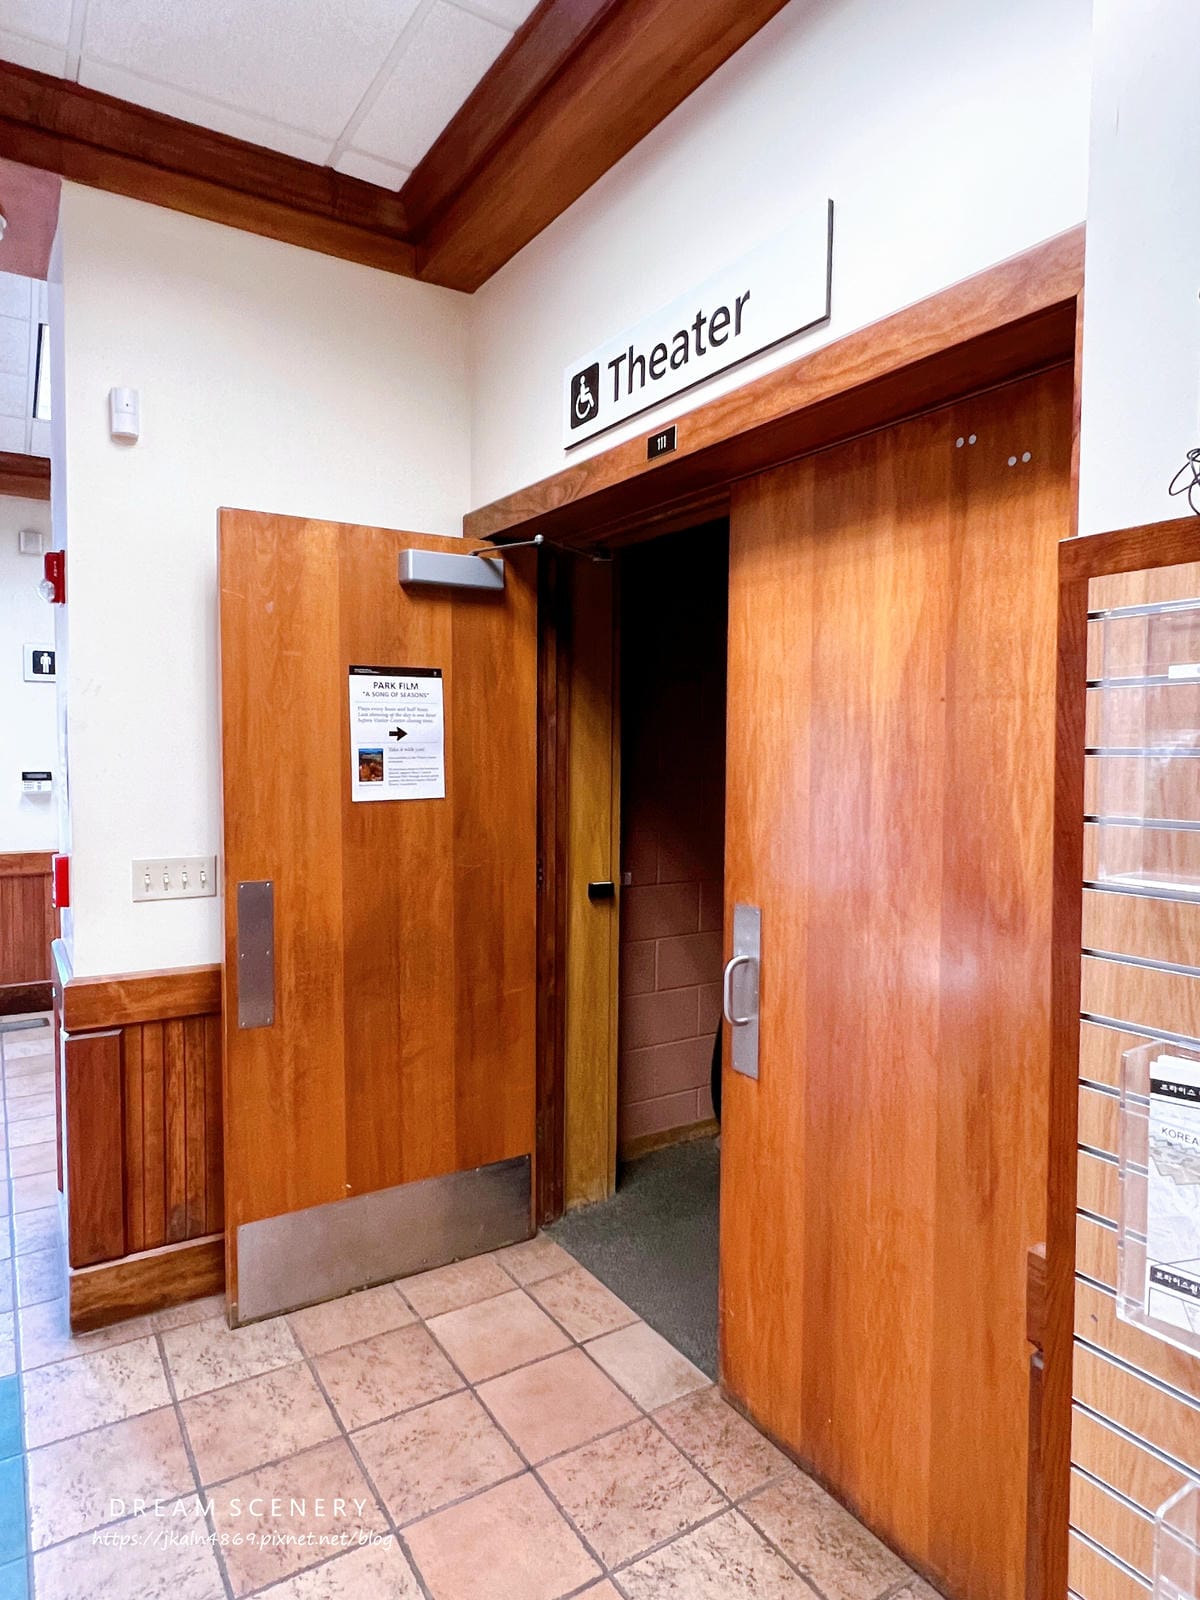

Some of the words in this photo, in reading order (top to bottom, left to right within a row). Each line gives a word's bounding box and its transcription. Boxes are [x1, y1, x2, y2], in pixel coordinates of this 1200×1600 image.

[607, 289, 750, 402] Theater
[656, 435, 667, 450] 111
[373, 681, 396, 690] PARK
[399, 682, 419, 690] FILM
[1161, 1127, 1199, 1146] KOREA
